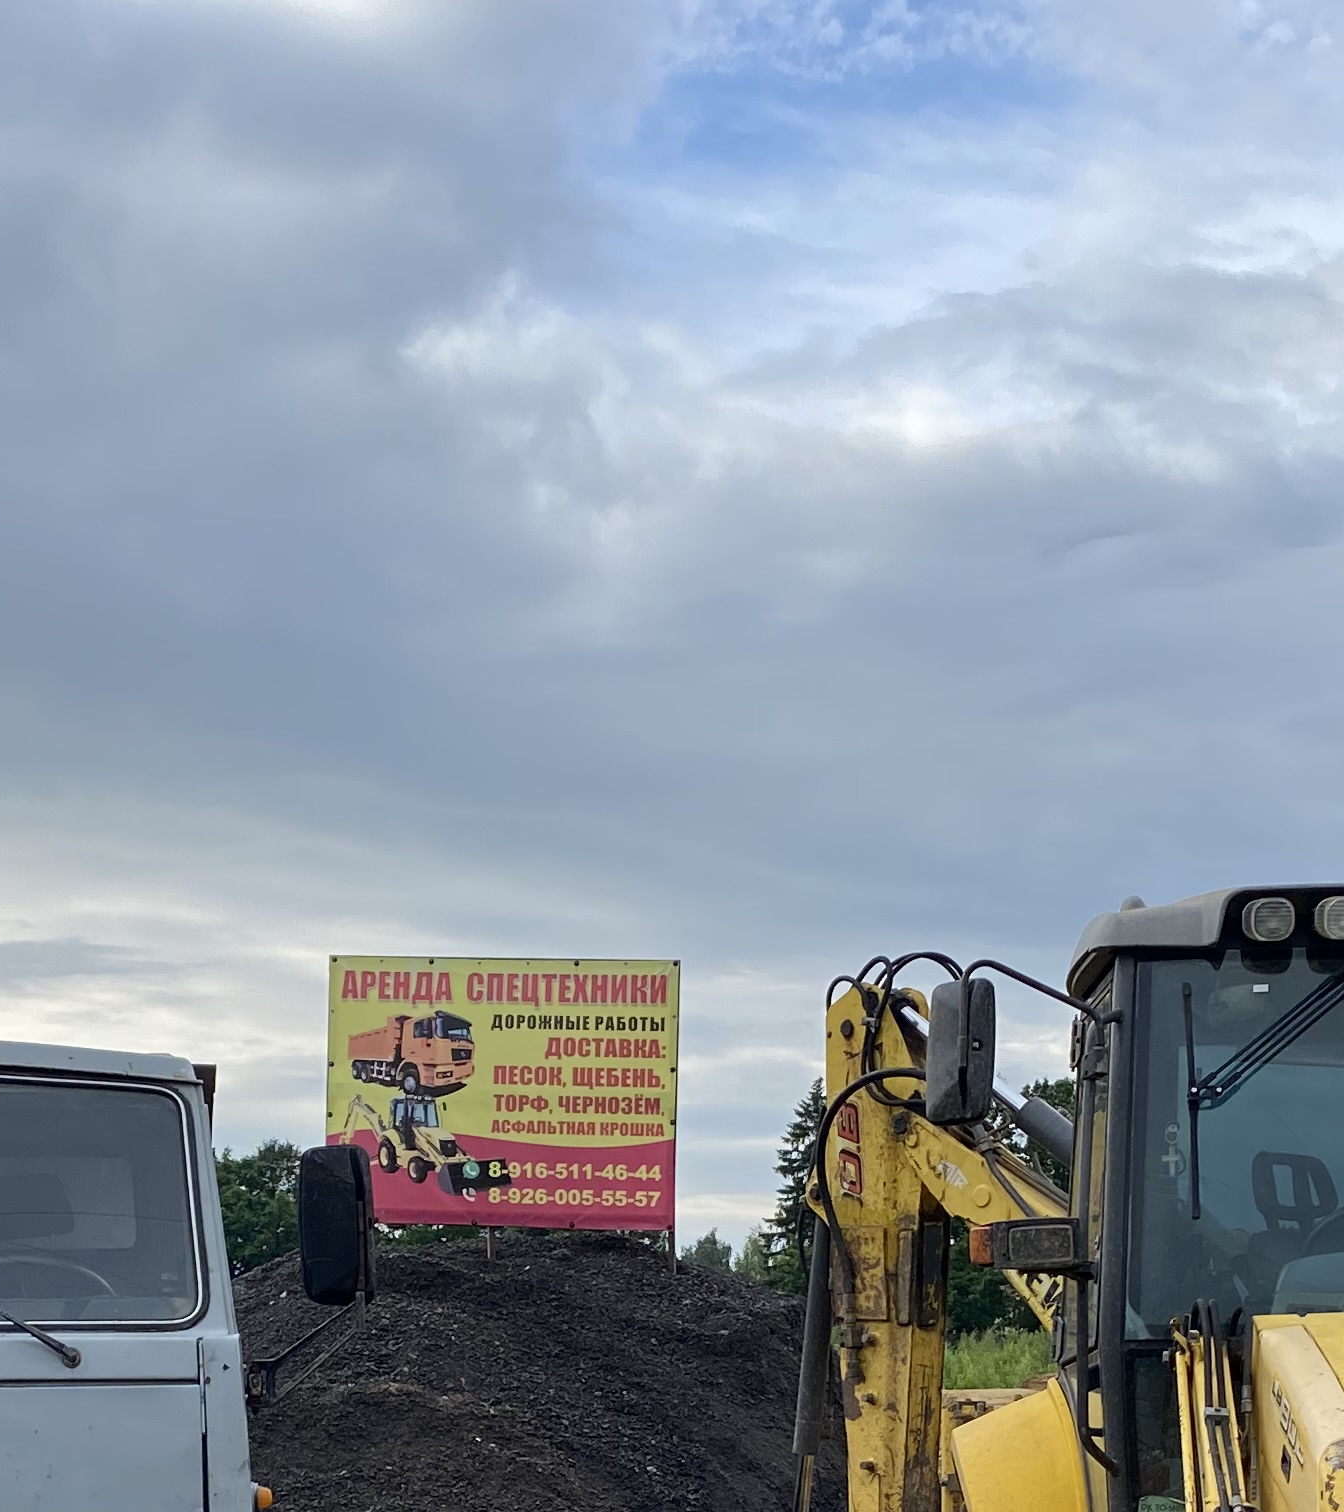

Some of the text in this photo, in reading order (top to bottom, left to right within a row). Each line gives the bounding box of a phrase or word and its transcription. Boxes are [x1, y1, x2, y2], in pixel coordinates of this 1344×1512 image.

[341, 970, 668, 1007] АРЕНДА СПЕЦТЕХНИКИ
[490, 1014, 665, 1032] ДОРОЖНЫЕ РАБОТЫ
[545, 1037, 667, 1060] ДОСТАВКА:
[493, 1065, 666, 1090] ПЕСОК, ЩЕБЕНЬ,
[493, 1094, 665, 1117] ТОРФ, ЧЕРНОЗЁМ,
[491, 1120, 665, 1137] АСФАЛЬТНАЯ КРОШКА
[488, 1161, 662, 1182] 8-916-511-46-44
[488, 1187, 662, 1207] 8-926-005-55-57
